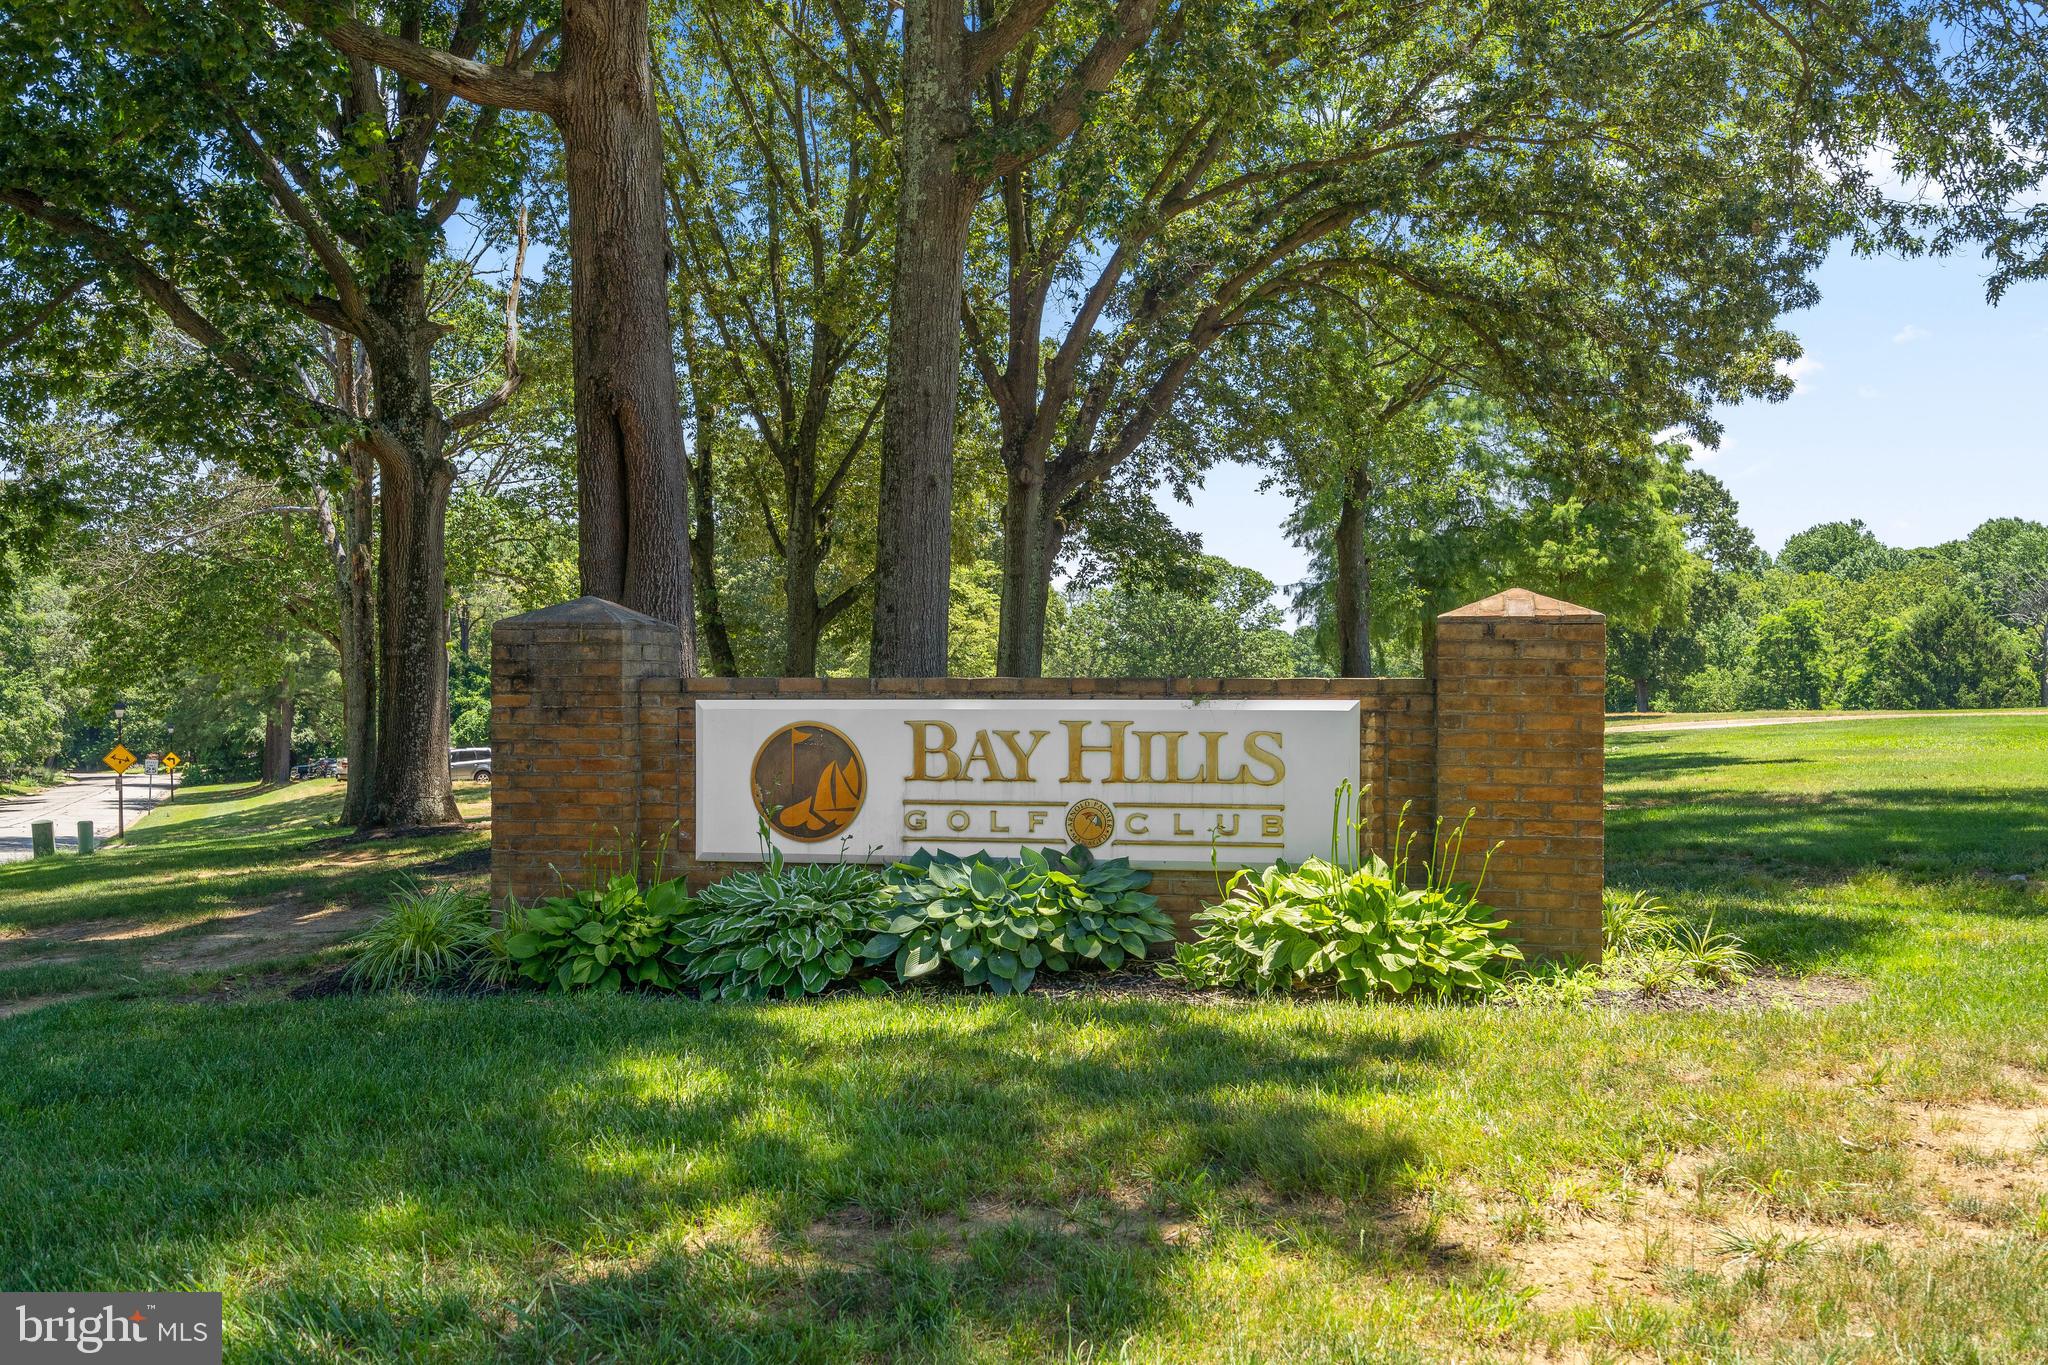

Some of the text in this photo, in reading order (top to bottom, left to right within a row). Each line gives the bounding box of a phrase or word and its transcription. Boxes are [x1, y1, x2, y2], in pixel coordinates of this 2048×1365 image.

[903, 810, 1285, 837] GOLF CLUB
[1067, 800, 1112, 829] ARNOLD PALMER
